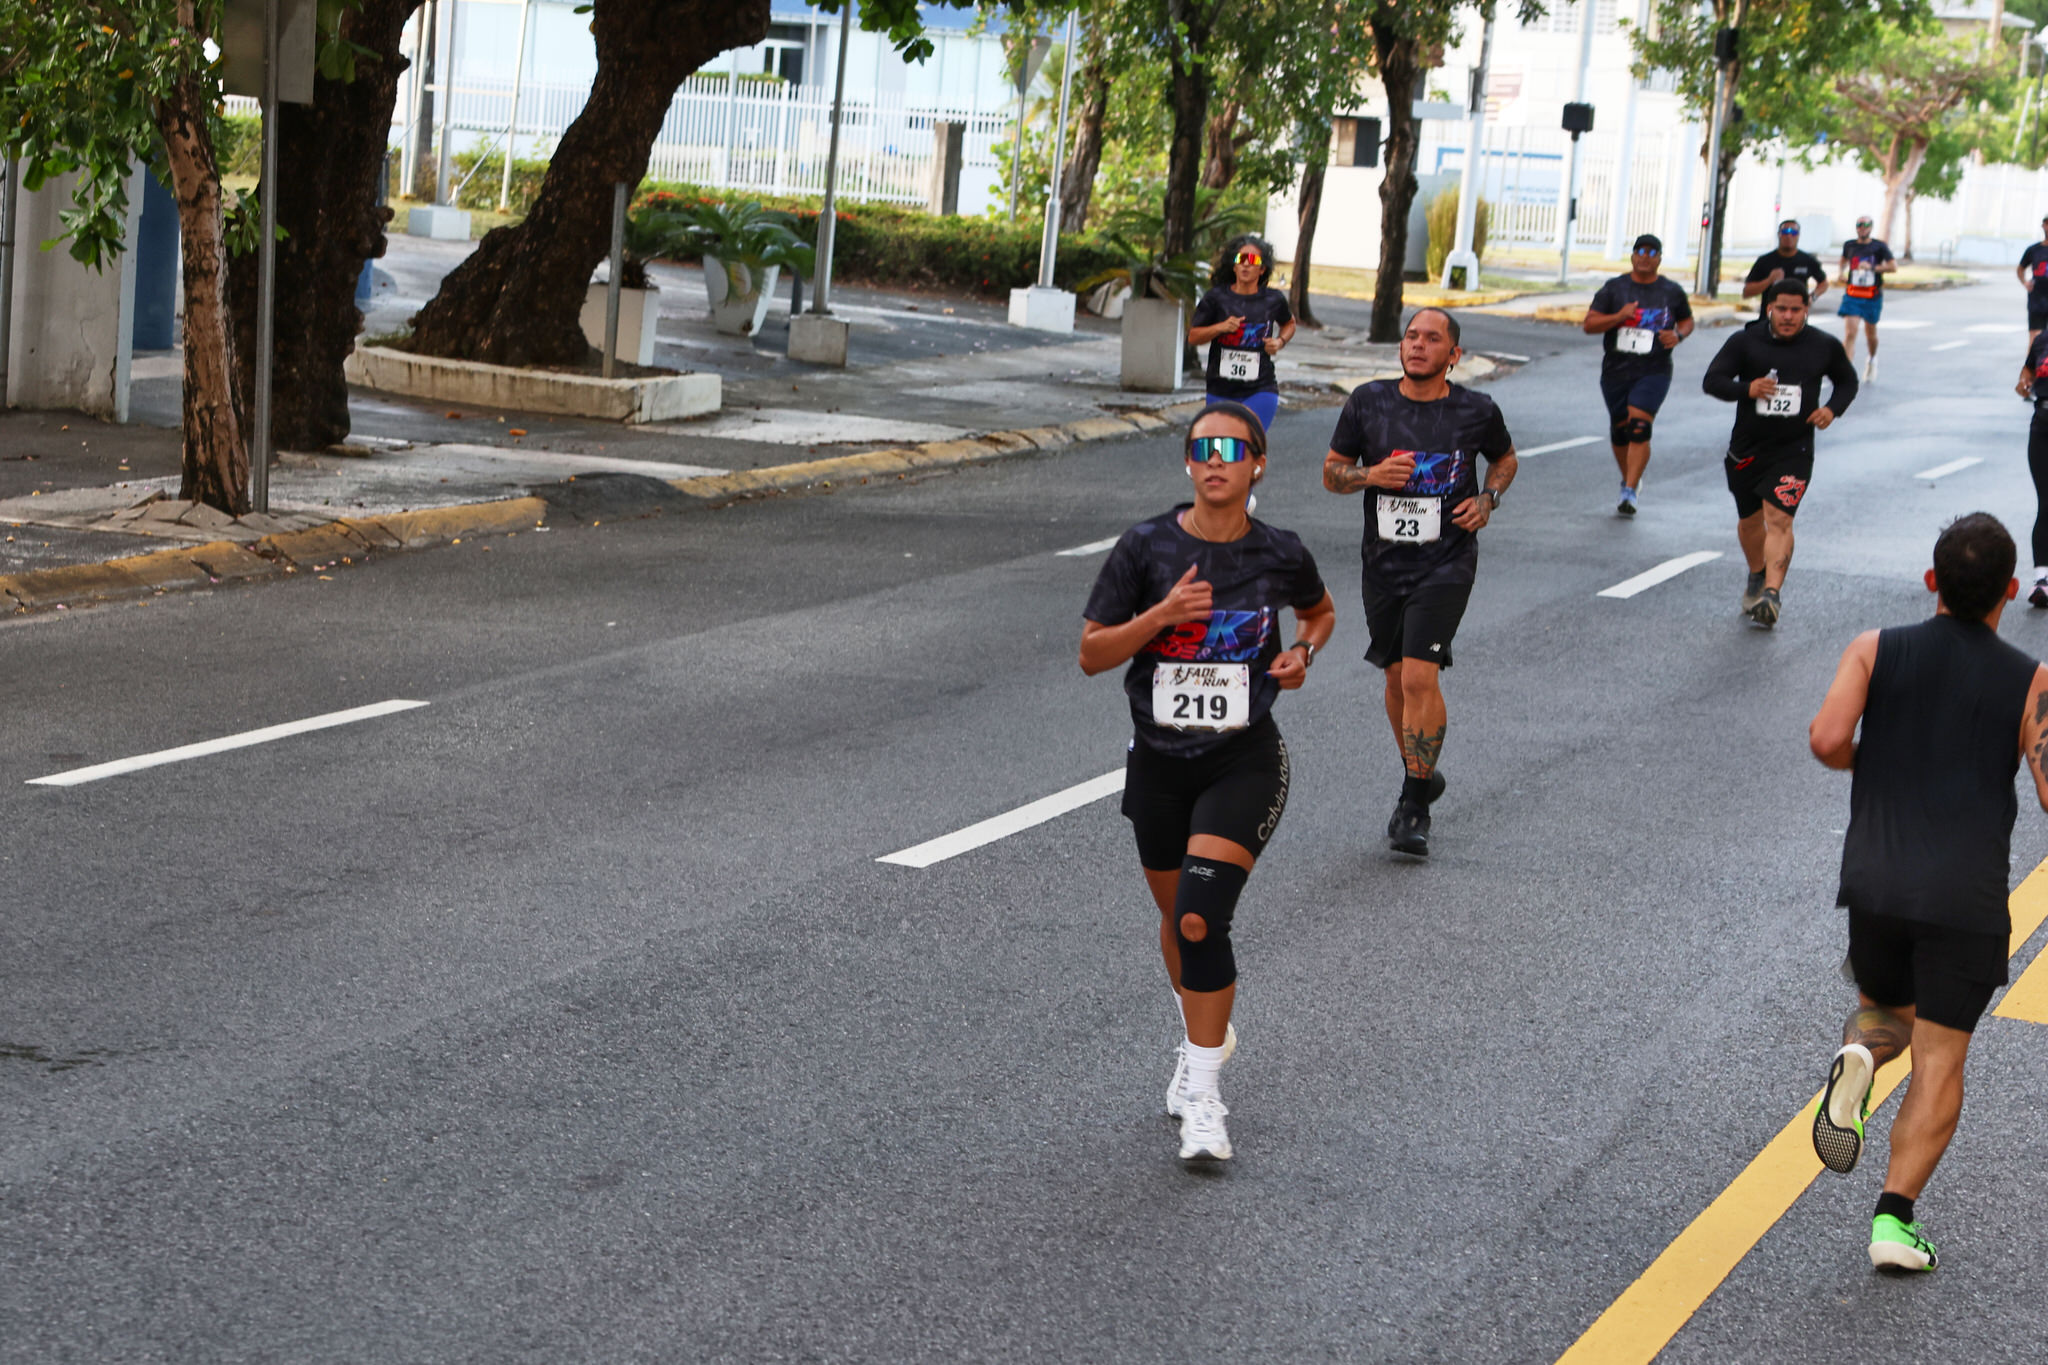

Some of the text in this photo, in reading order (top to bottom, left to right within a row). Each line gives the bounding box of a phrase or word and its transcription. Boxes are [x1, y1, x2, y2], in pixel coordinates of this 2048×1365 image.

[1230, 364, 1247, 376] 36
[1766, 399, 1791, 412] 132
[1395, 518, 1419, 537] 23
[1185, 666, 1218, 680] FADE
[1202, 678, 1229, 687] RUN
[1173, 693, 1228, 720] 219
[1257, 738, 1290, 842] Calvin Klein
[1188, 865, 1216, 877] ACE
